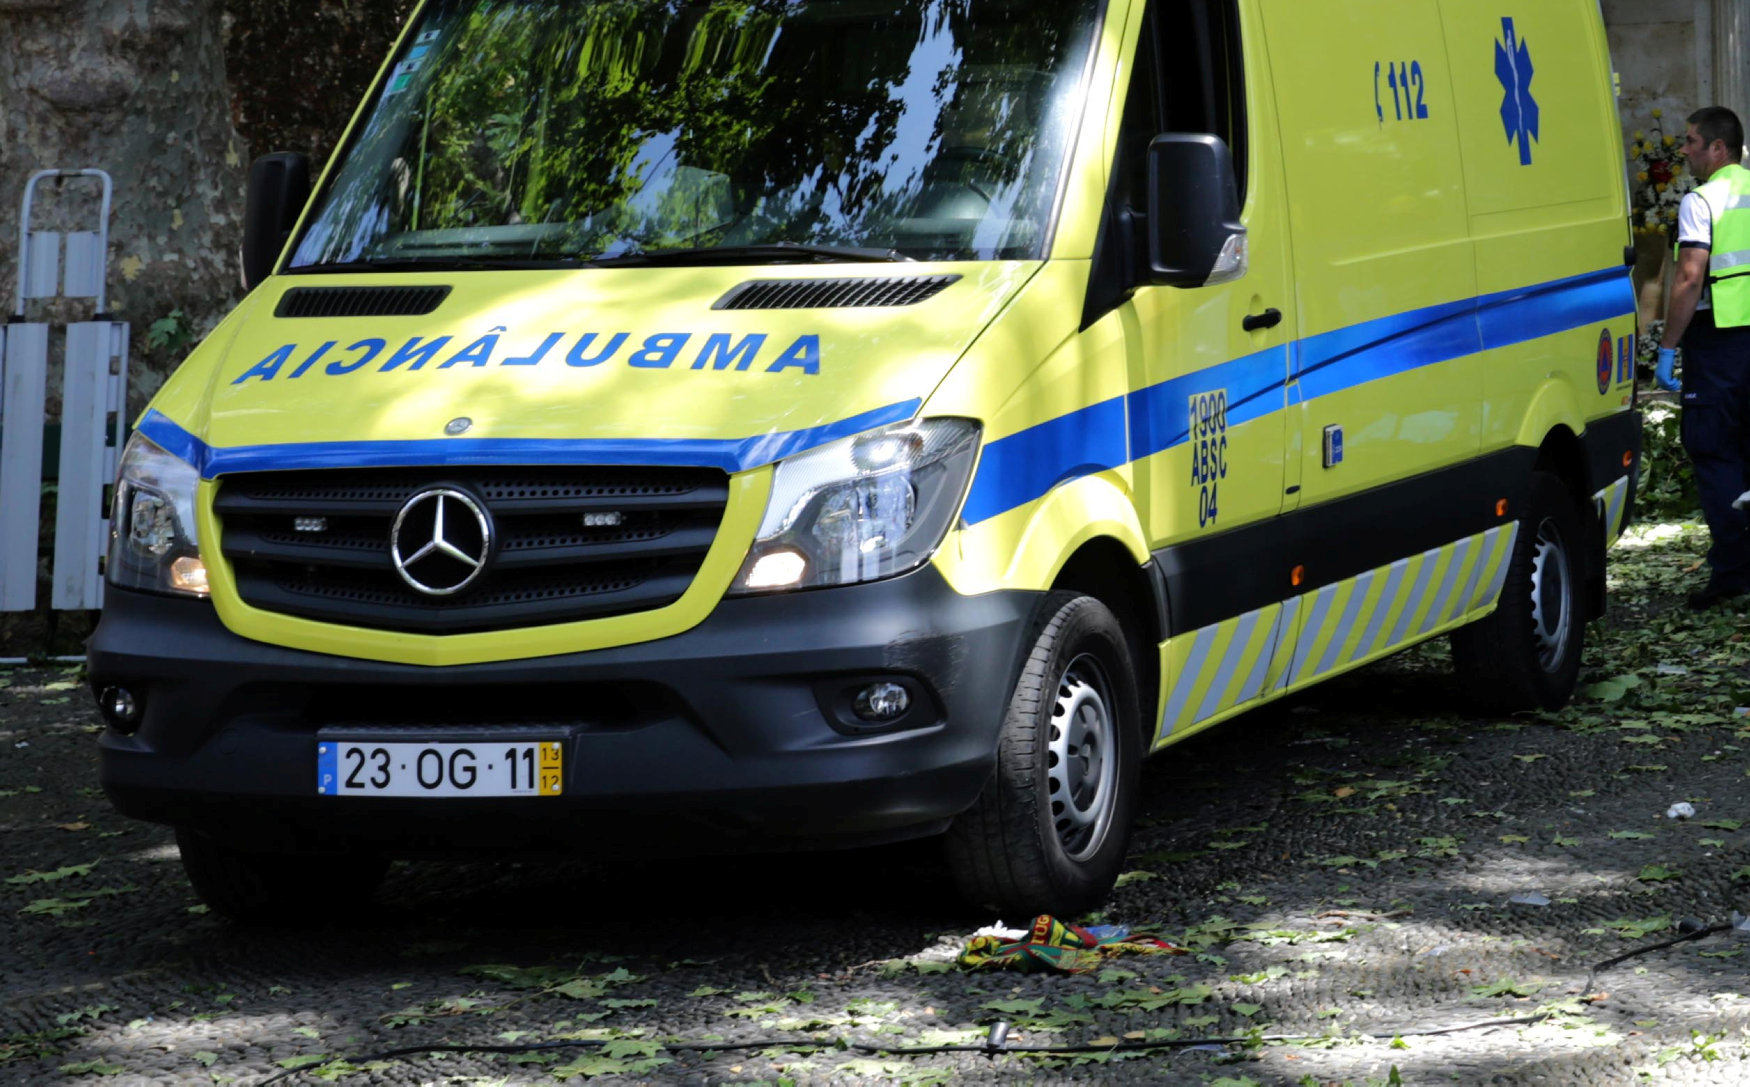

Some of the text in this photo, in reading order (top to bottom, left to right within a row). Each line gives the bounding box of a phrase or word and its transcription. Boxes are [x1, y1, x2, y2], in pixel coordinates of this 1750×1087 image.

[1388, 59, 1428, 120] 112
[1190, 391, 1227, 440] 1900
[1190, 435, 1227, 487] ABSC
[1199, 482, 1218, 528] 04
[323, 774, 332, 785] P
